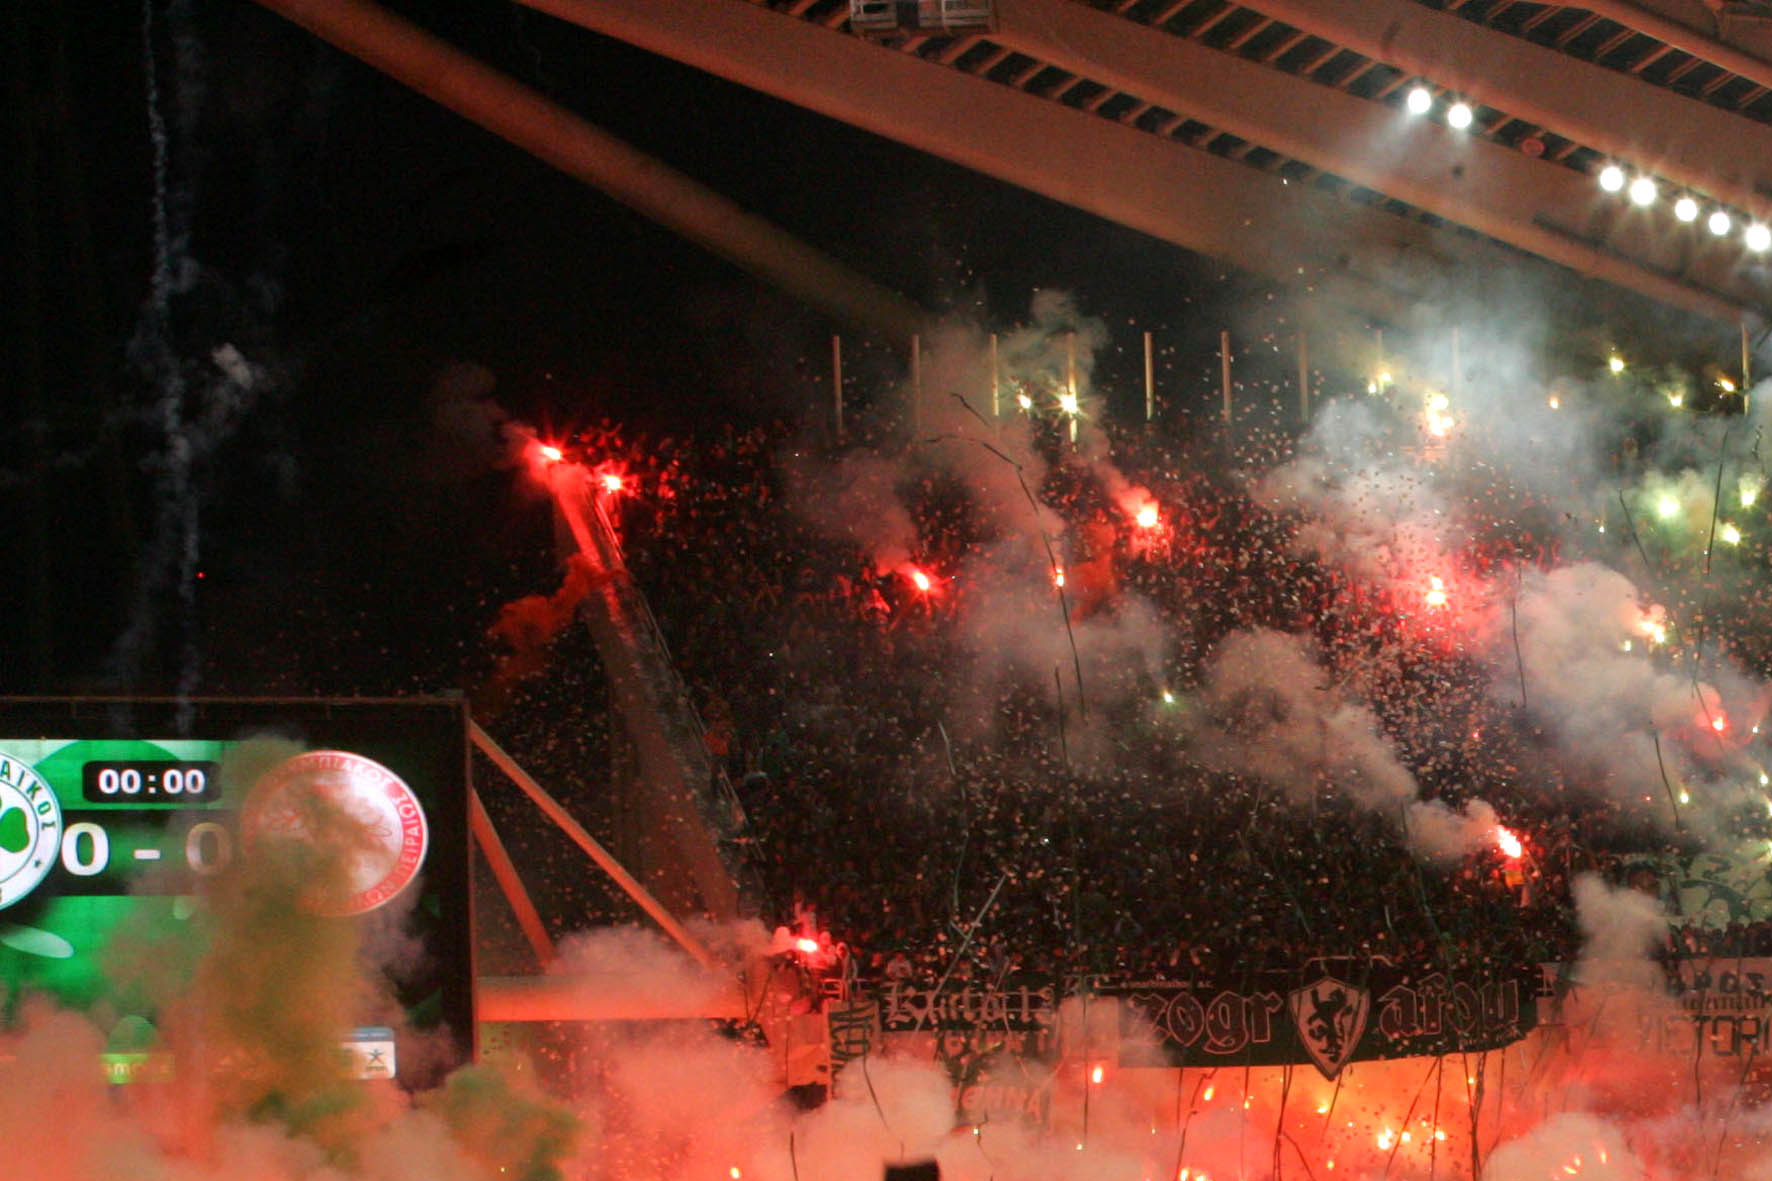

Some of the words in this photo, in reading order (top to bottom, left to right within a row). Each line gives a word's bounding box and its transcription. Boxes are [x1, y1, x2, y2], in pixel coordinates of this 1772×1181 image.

[98, 768, 206, 795] 00:00
[61, 821, 110, 877] 0
[185, 822, 233, 877] 0
